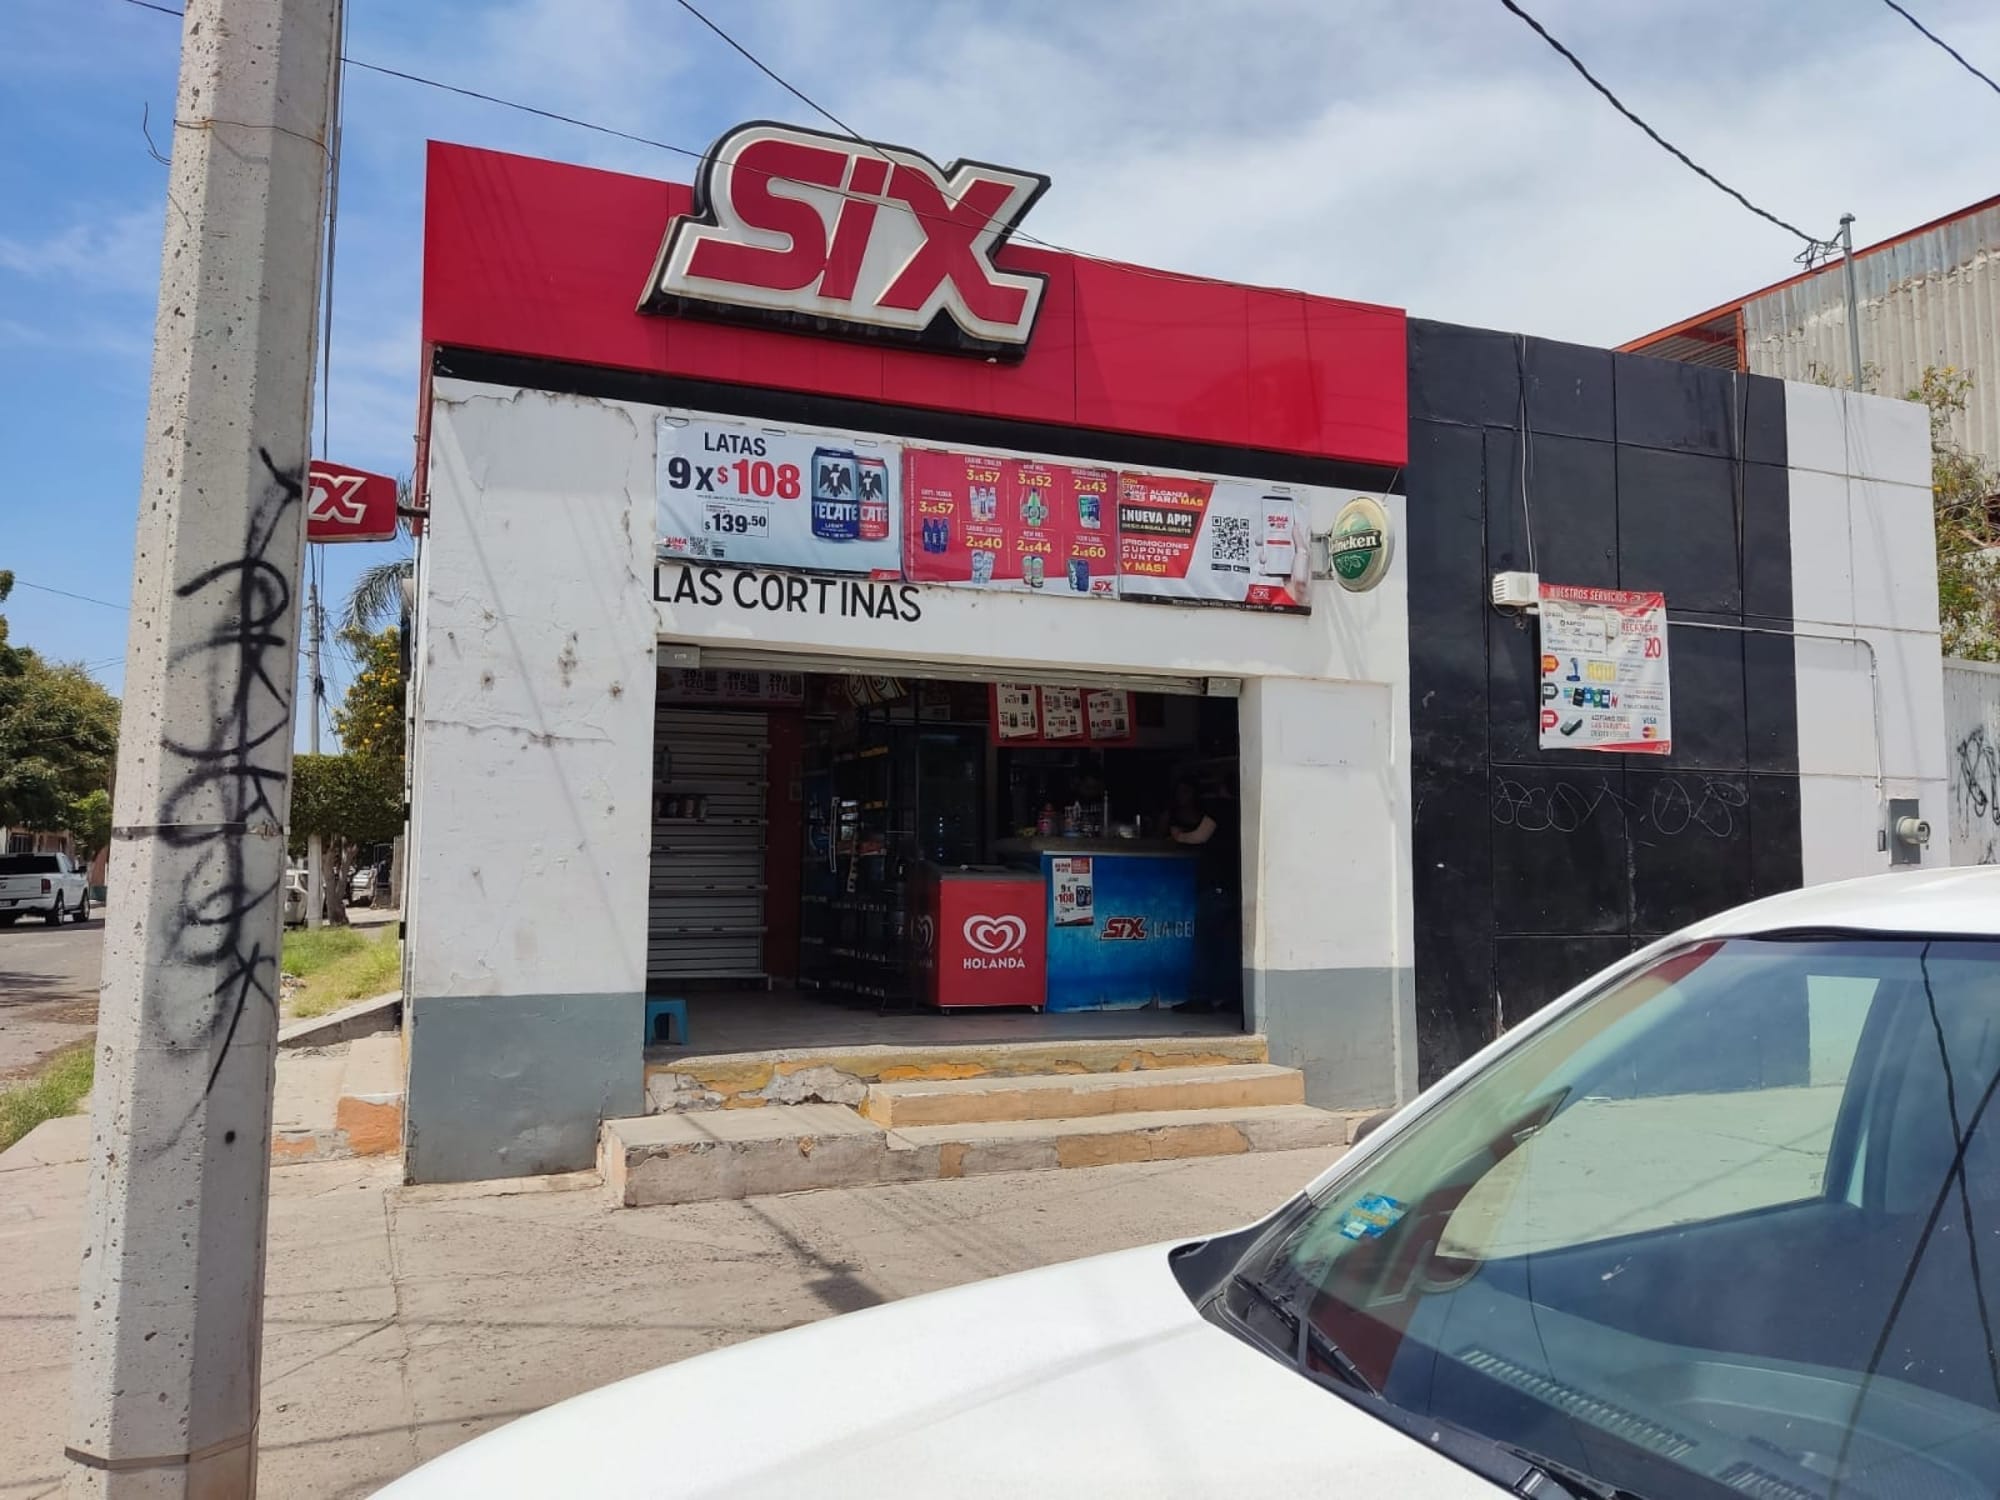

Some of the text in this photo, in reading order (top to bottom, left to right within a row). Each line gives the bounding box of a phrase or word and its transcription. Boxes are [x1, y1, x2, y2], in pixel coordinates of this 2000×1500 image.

[704, 432, 766, 456] LATAS
[814, 501, 858, 521] TECATE
[1166, 512, 1192, 528] APP!
[1122, 546, 1180, 556] CUPONES
[1122, 553, 1169, 562] PUNTOS
[1123, 561, 1132, 571] Y
[653, 566, 922, 623] LAS CORTINAS
[1644, 637, 1661, 658] 20
[963, 957, 1025, 969] HOLANDA
